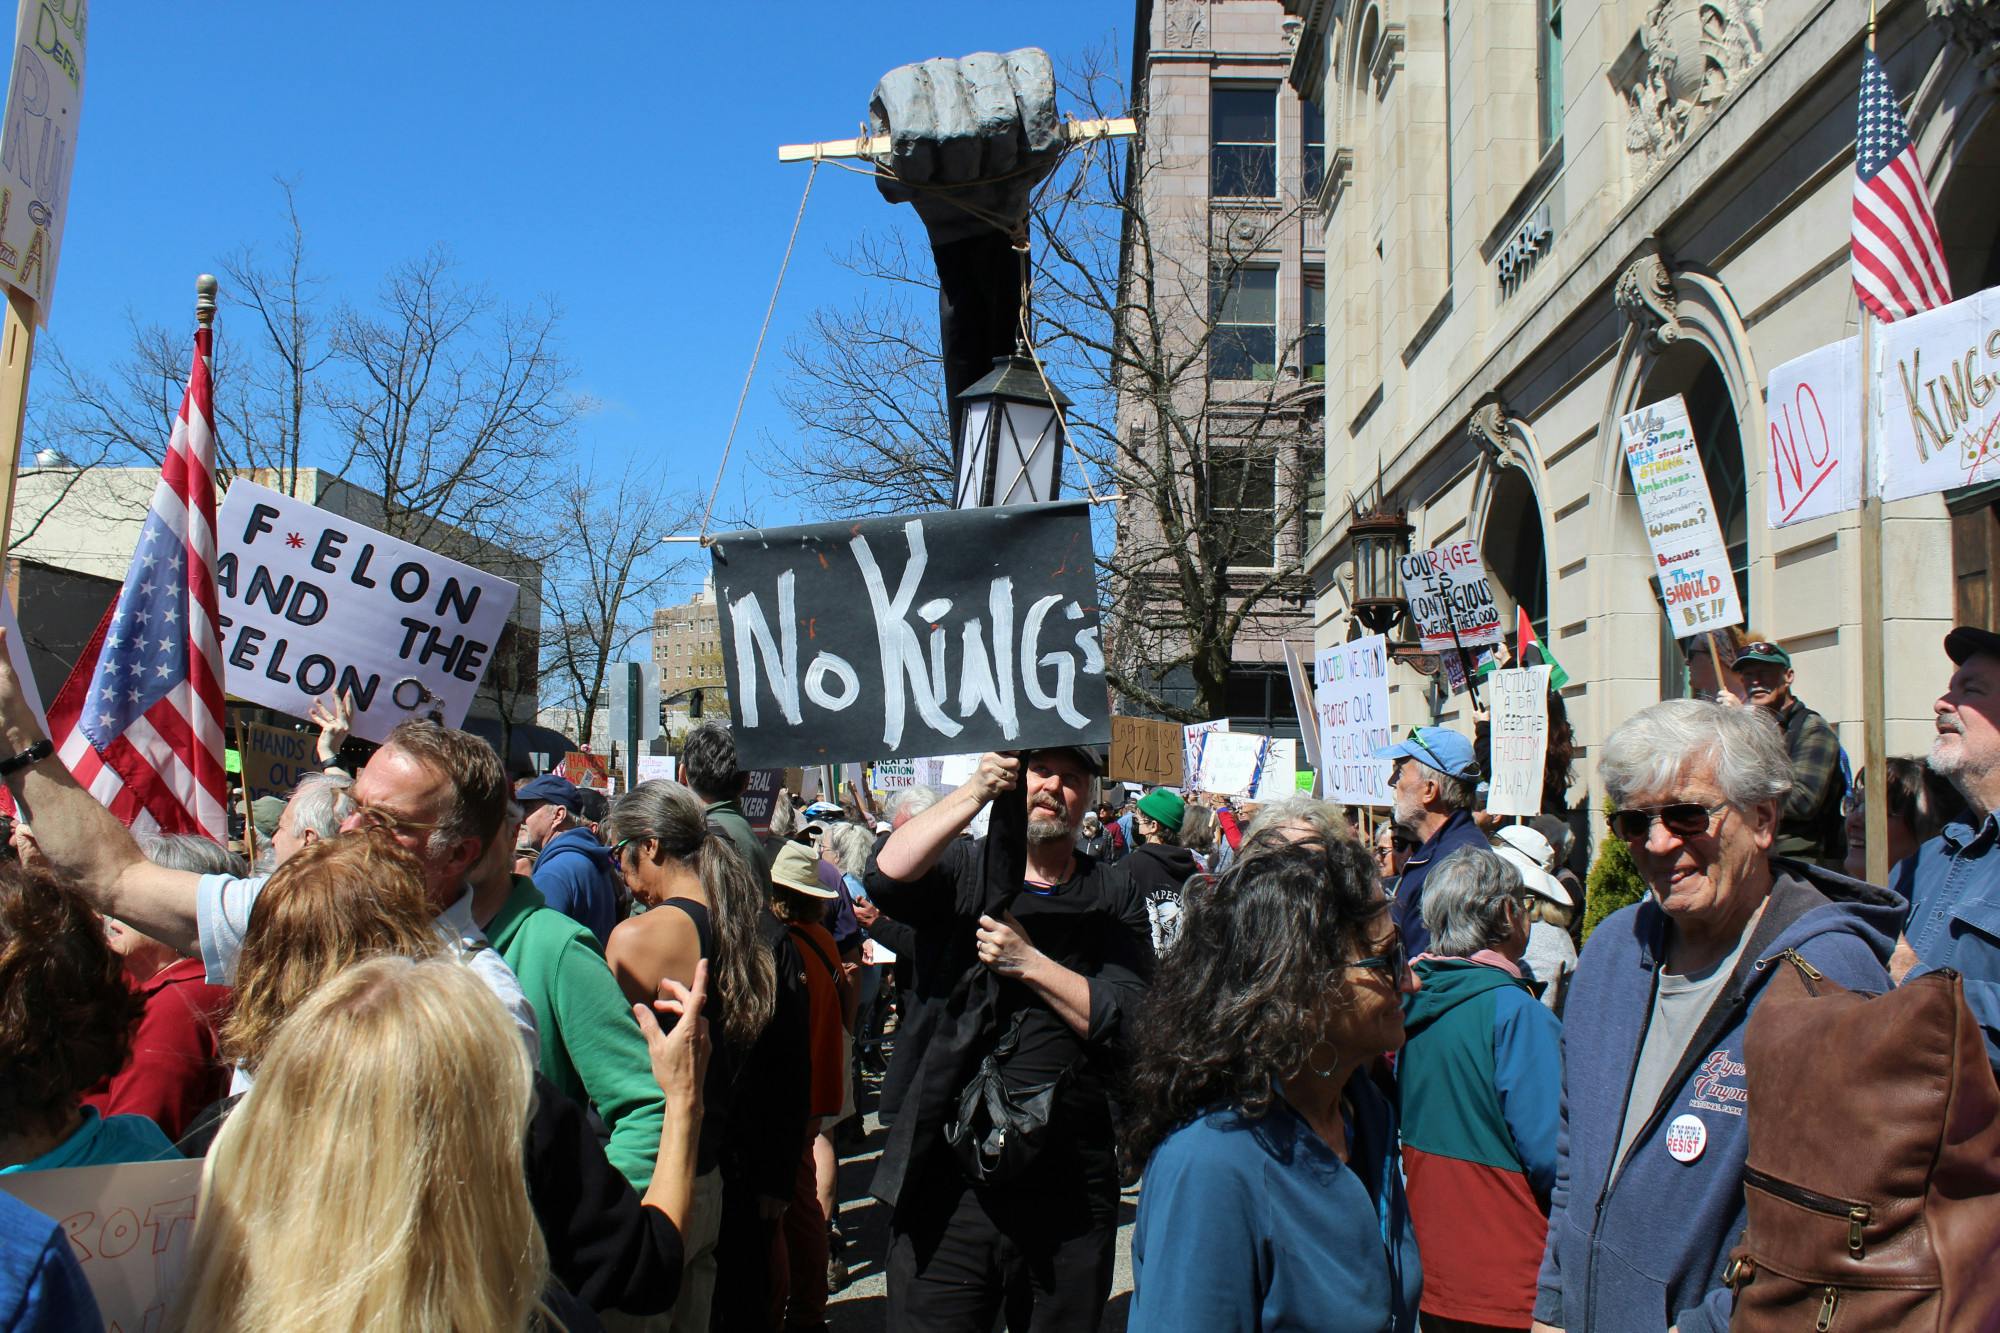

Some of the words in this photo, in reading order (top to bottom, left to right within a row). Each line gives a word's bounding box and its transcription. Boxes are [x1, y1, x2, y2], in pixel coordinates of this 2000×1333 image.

[0, 188, 53, 300] LA
[1897, 329, 2000, 464] KINGS
[1771, 382, 1830, 511] NO
[1400, 543, 1477, 581] COURAGE
[1657, 549, 1700, 567] Because
[217, 552, 328, 626] AND
[1422, 571, 1454, 593] IS
[1666, 576, 1721, 606] SHOULD
[1683, 598, 1726, 627] BE!!
[399, 617, 488, 682] THE
[1319, 653, 1345, 684] UNITED
[1349, 650, 1360, 681] WE
[1361, 644, 1385, 681] STAND
[1495, 671, 1545, 696] ACTIVISM
[1323, 700, 1349, 729] PROTECT
[1353, 692, 1374, 724] OUR
[1504, 695, 1510, 710] A
[1518, 694, 1538, 712] DAY
[1112, 719, 1180, 749] CAPITALISM
[1526, 713, 1544, 735] THE
[252, 730, 306, 761] HANDS
[1121, 743, 1176, 776] KILLS
[1332, 731, 1360, 760] RIGHTS
[1495, 736, 1540, 762] FASCISM
[747, 770, 771, 791] ERAL
[880, 765, 914, 776] NATION
[884, 776, 915, 788] STRIK
[1328, 764, 1341, 793] NO
[1343, 764, 1384, 799] DICTATORS
[1493, 768, 1533, 797] AWAY
[1694, 1073, 1747, 1103] Canyon
[1721, 1104, 1743, 1116] PARK
[1667, 1137, 1699, 1154] RESIST
